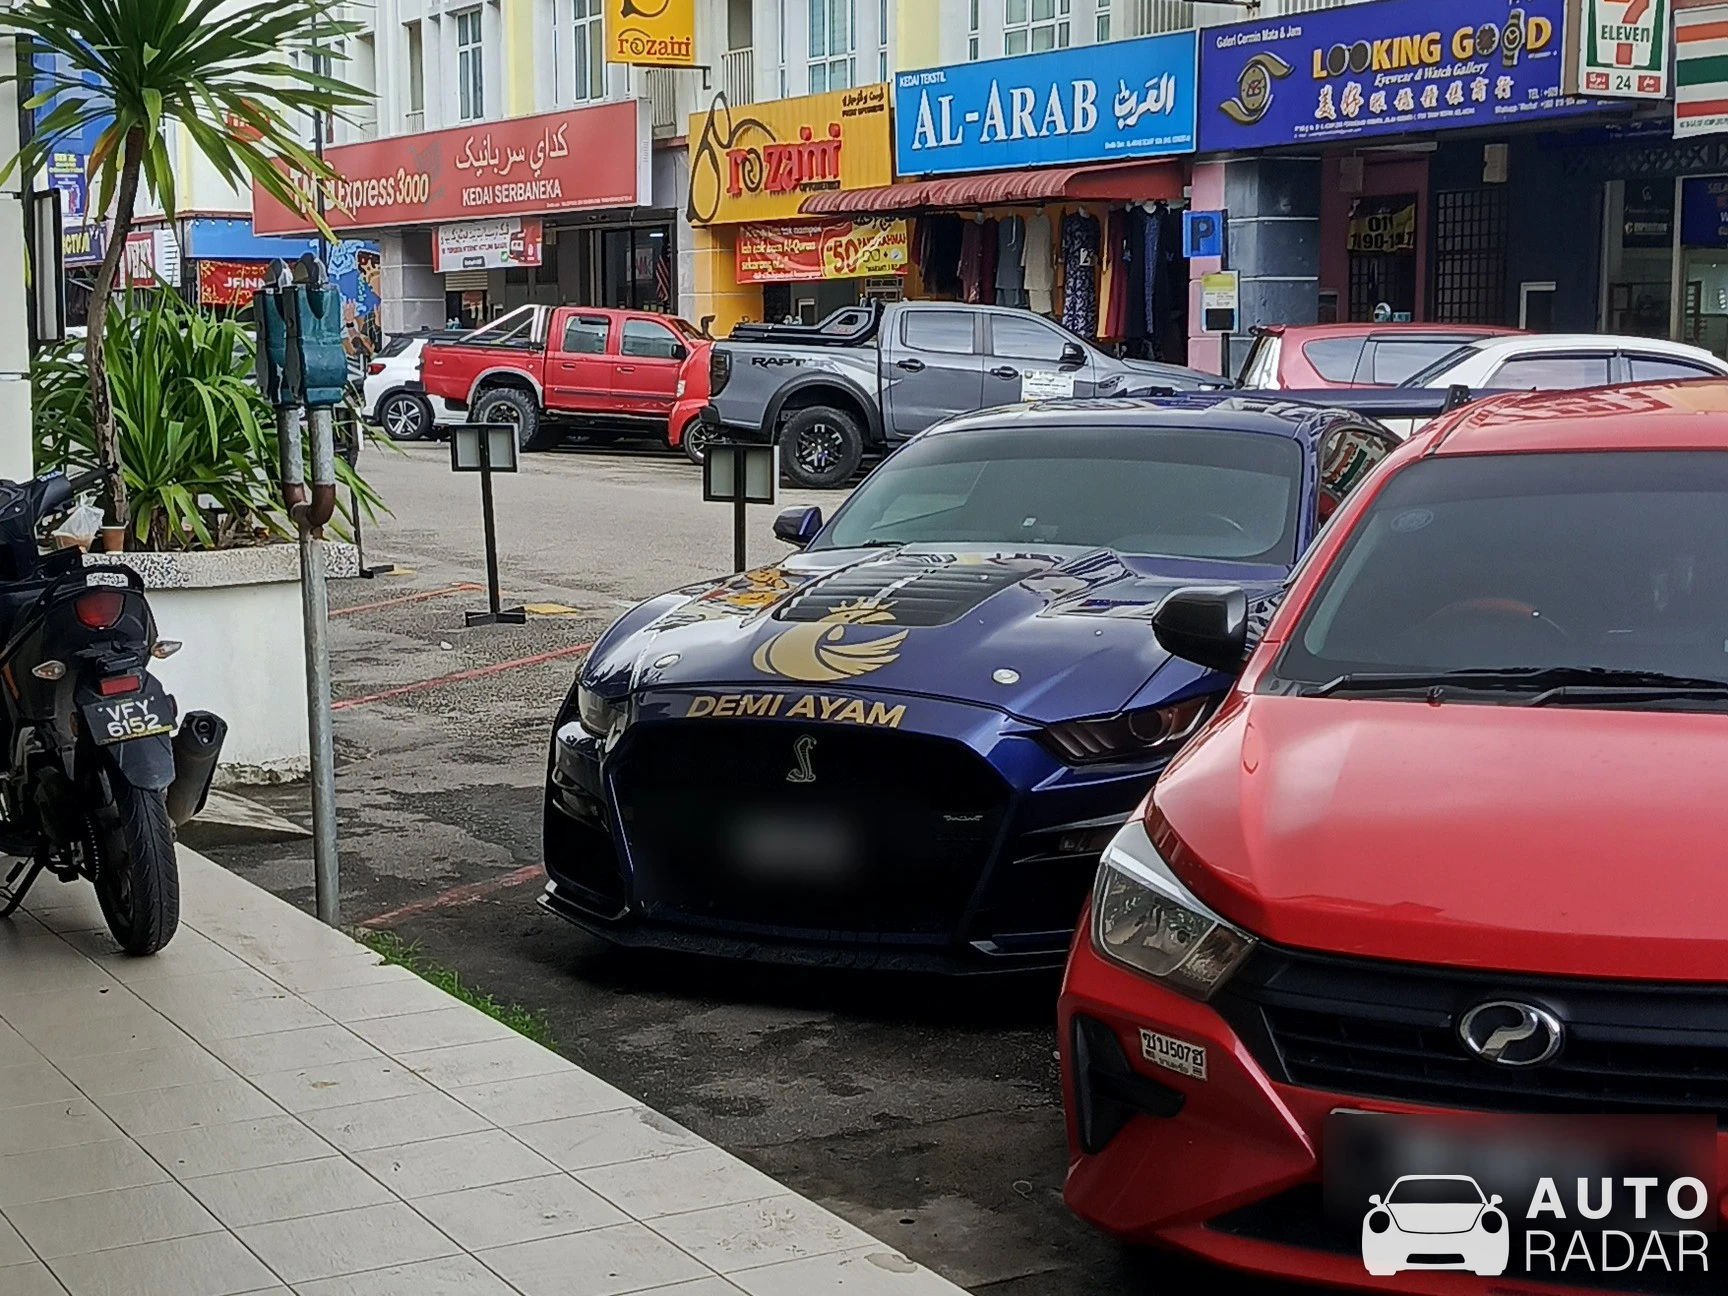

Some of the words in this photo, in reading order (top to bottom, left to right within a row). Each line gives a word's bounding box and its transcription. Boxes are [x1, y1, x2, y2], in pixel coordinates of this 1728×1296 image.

[1262, 28, 1279, 41] Mata
[1312, 32, 1441, 78] LOOKING
[1452, 12, 1552, 63] GOOD
[1374, 70, 1413, 88] Eyewear
[1423, 63, 1452, 80] Watch
[1453, 61, 1489, 75] Gallery
[1616, 75, 1631, 90] 24
[912, 79, 1098, 150] AL-ARAB
[396, 167, 429, 204] 3000
[462, 184, 492, 206] KEDAI
[495, 179, 562, 203] SERBANEKA
[1191, 216, 1215, 252] P
[752, 357, 828, 369] RAPT
[106, 699, 149, 722] VFY
[685, 694, 784, 717] DEMI
[785, 695, 907, 728] AYAM
[107, 713, 161, 739] 6152
